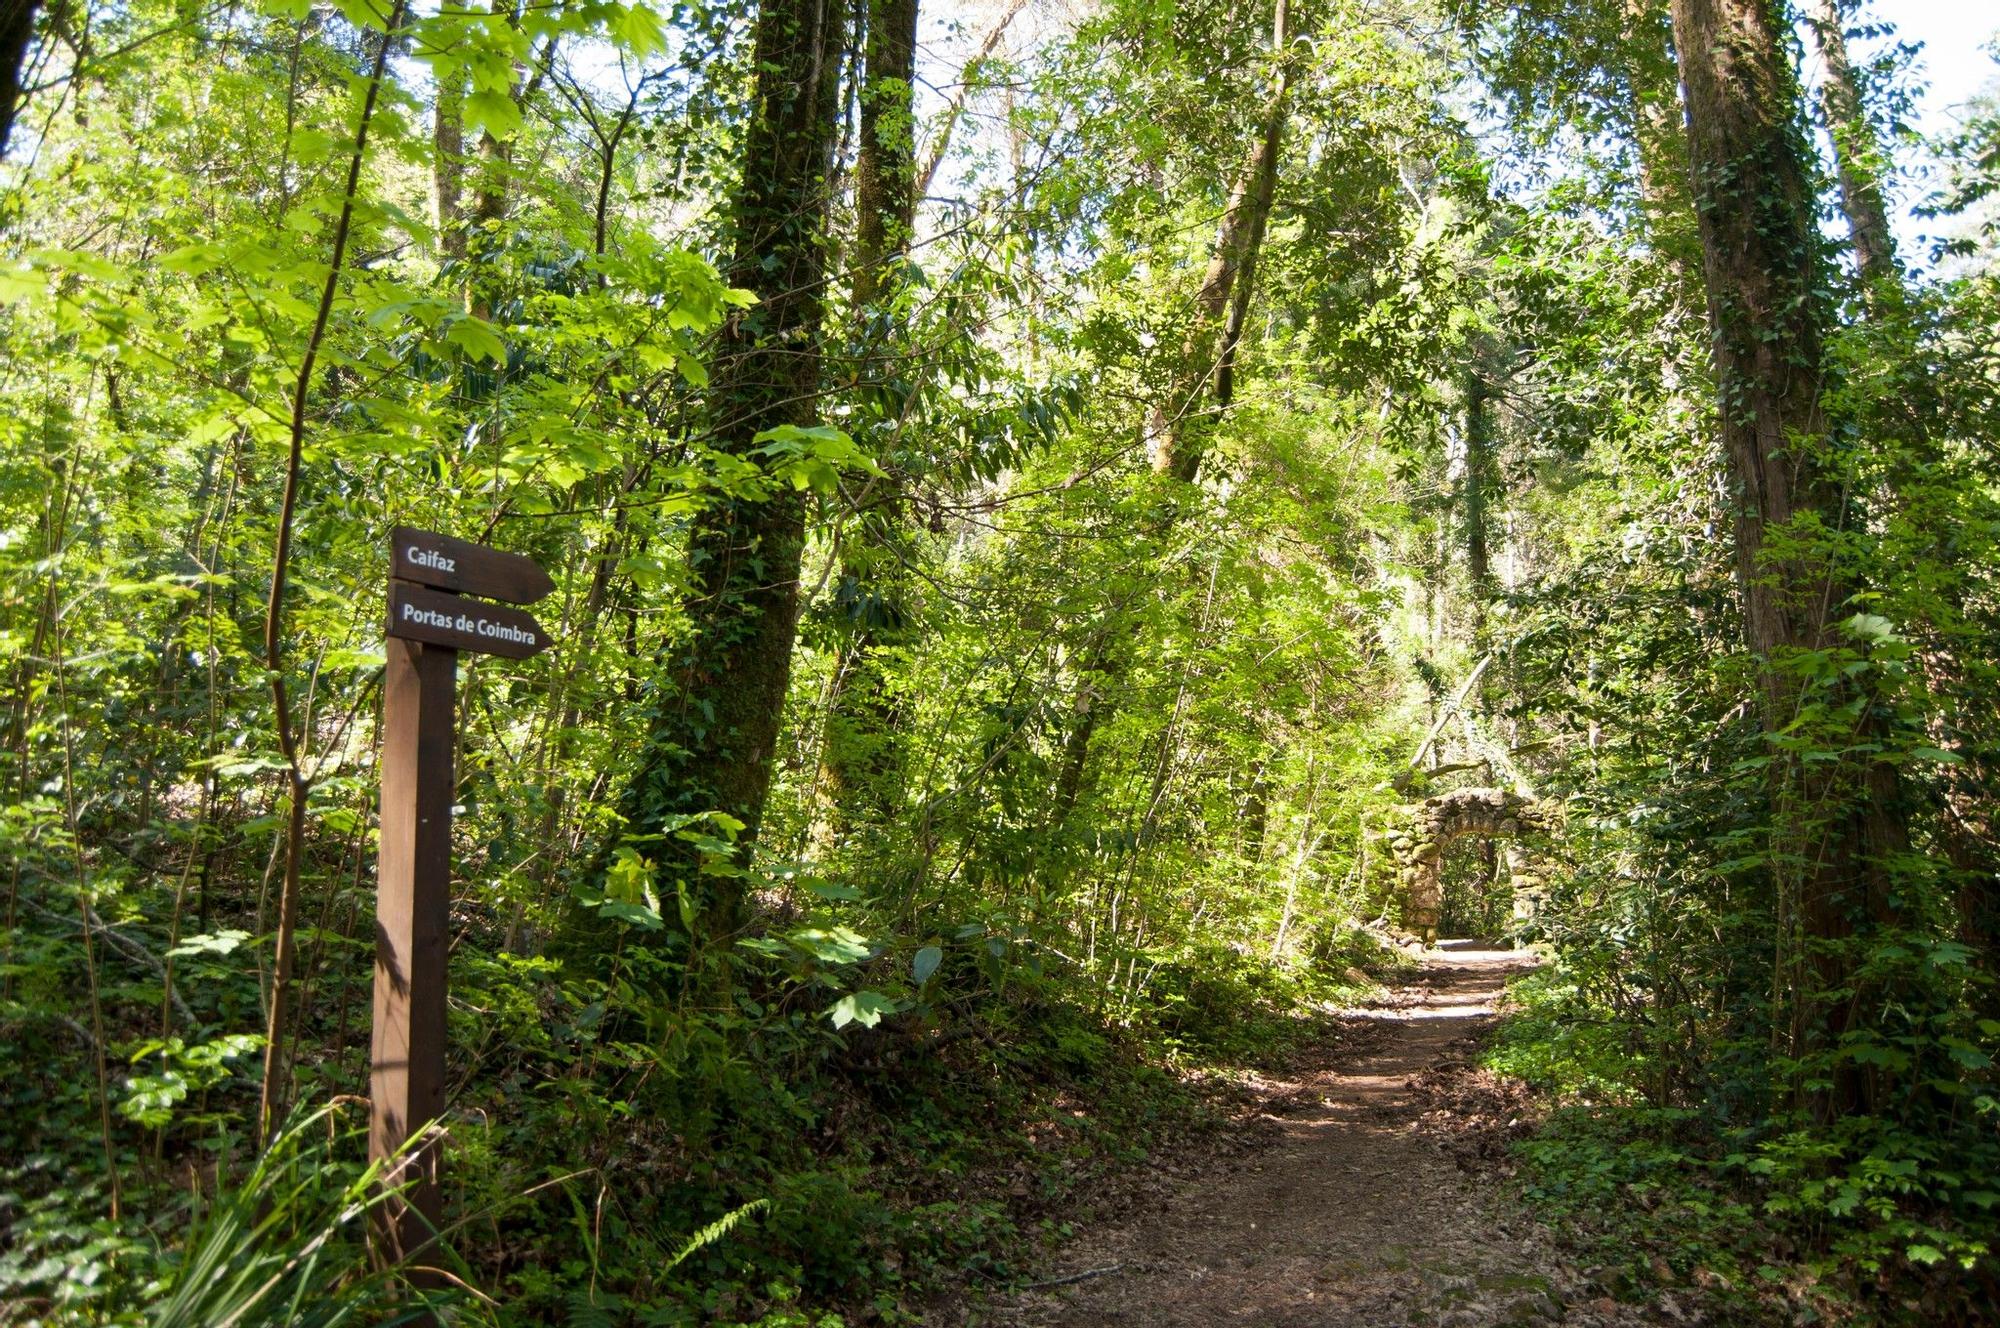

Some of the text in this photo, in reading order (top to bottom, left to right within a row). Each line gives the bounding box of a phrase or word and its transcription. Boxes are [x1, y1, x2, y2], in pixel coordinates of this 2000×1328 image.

[407, 546, 456, 572] Caifaz
[403, 603, 536, 645] Portas de Coimbra
